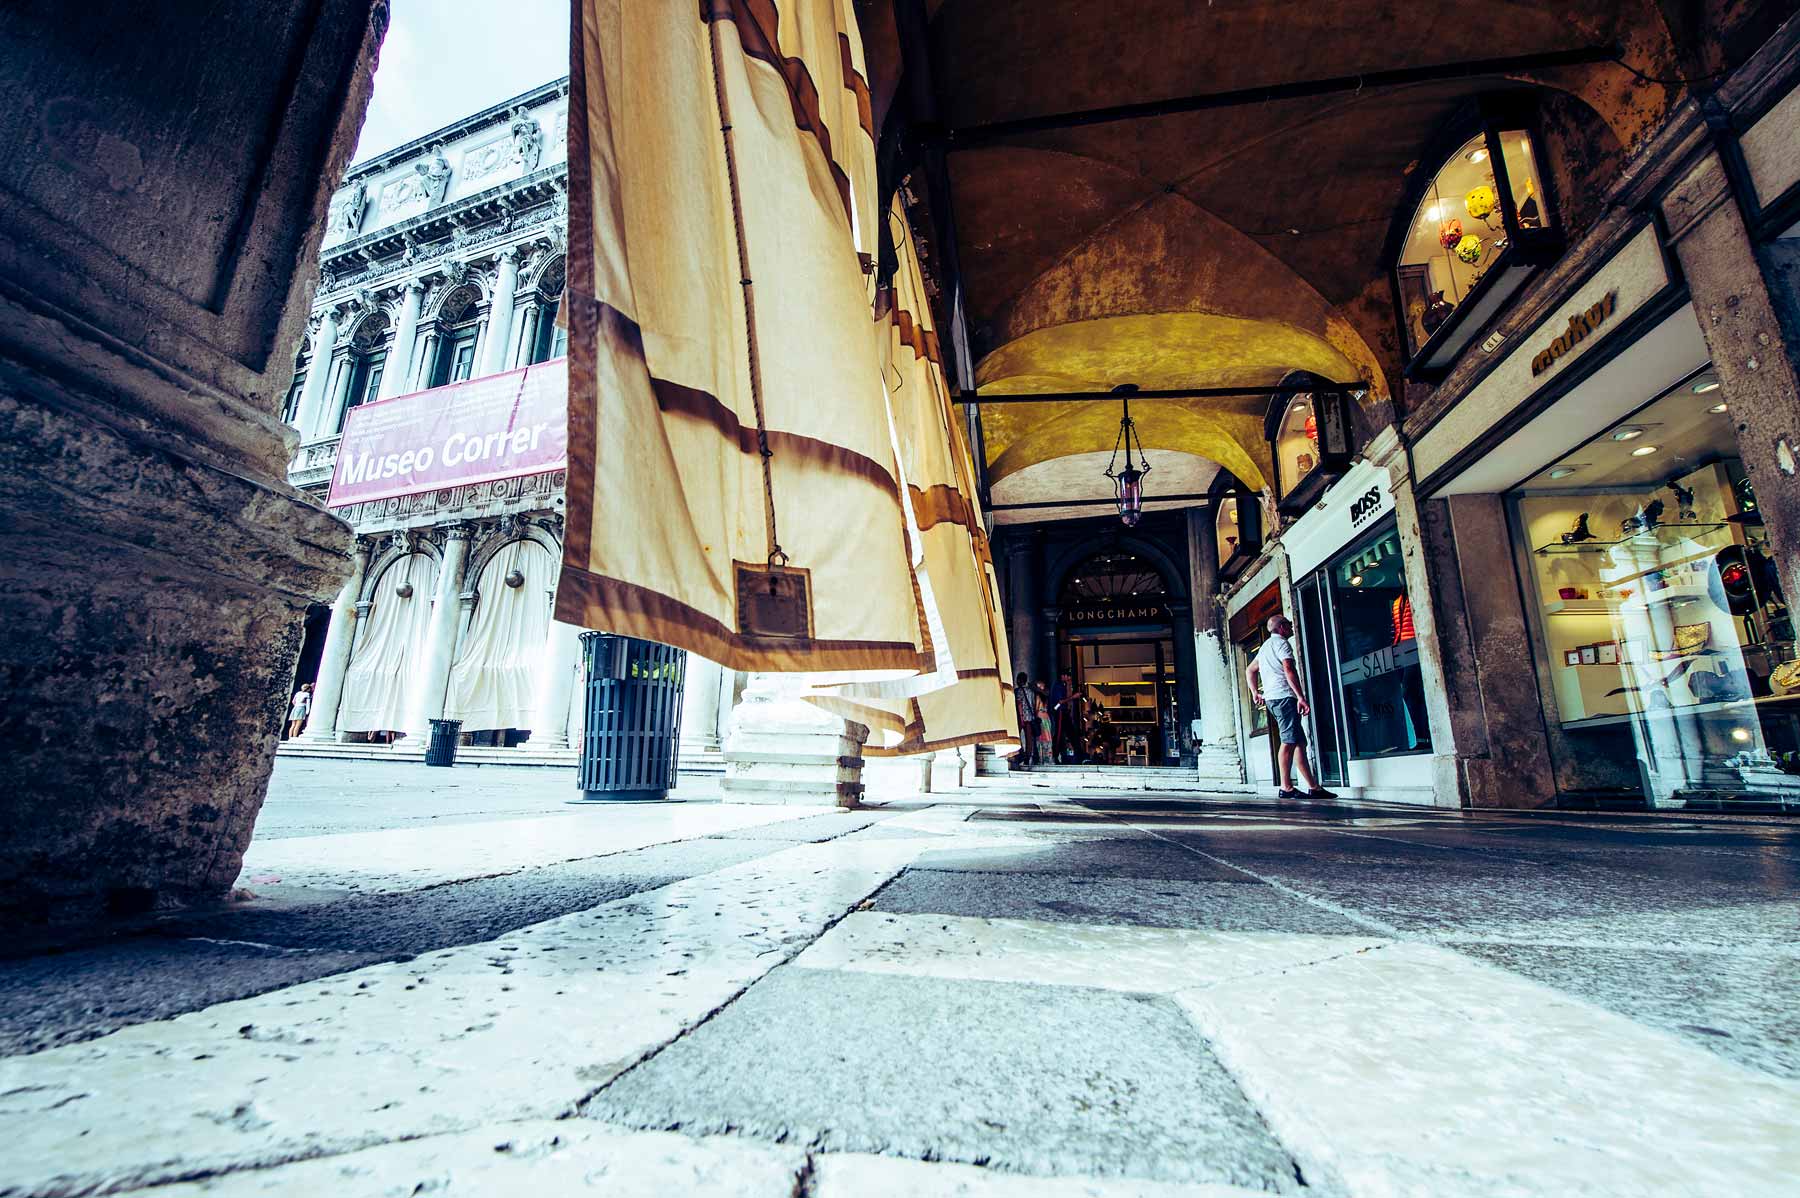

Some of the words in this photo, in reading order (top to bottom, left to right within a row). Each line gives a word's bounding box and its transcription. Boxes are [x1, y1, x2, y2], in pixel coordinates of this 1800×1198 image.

[340, 446, 434, 486] Museo
[442, 422, 547, 467] Correr
[1350, 485, 1381, 522] BOSS
[1069, 607, 1158, 621] LONGCHAMP
[1362, 644, 1402, 679] SALE
